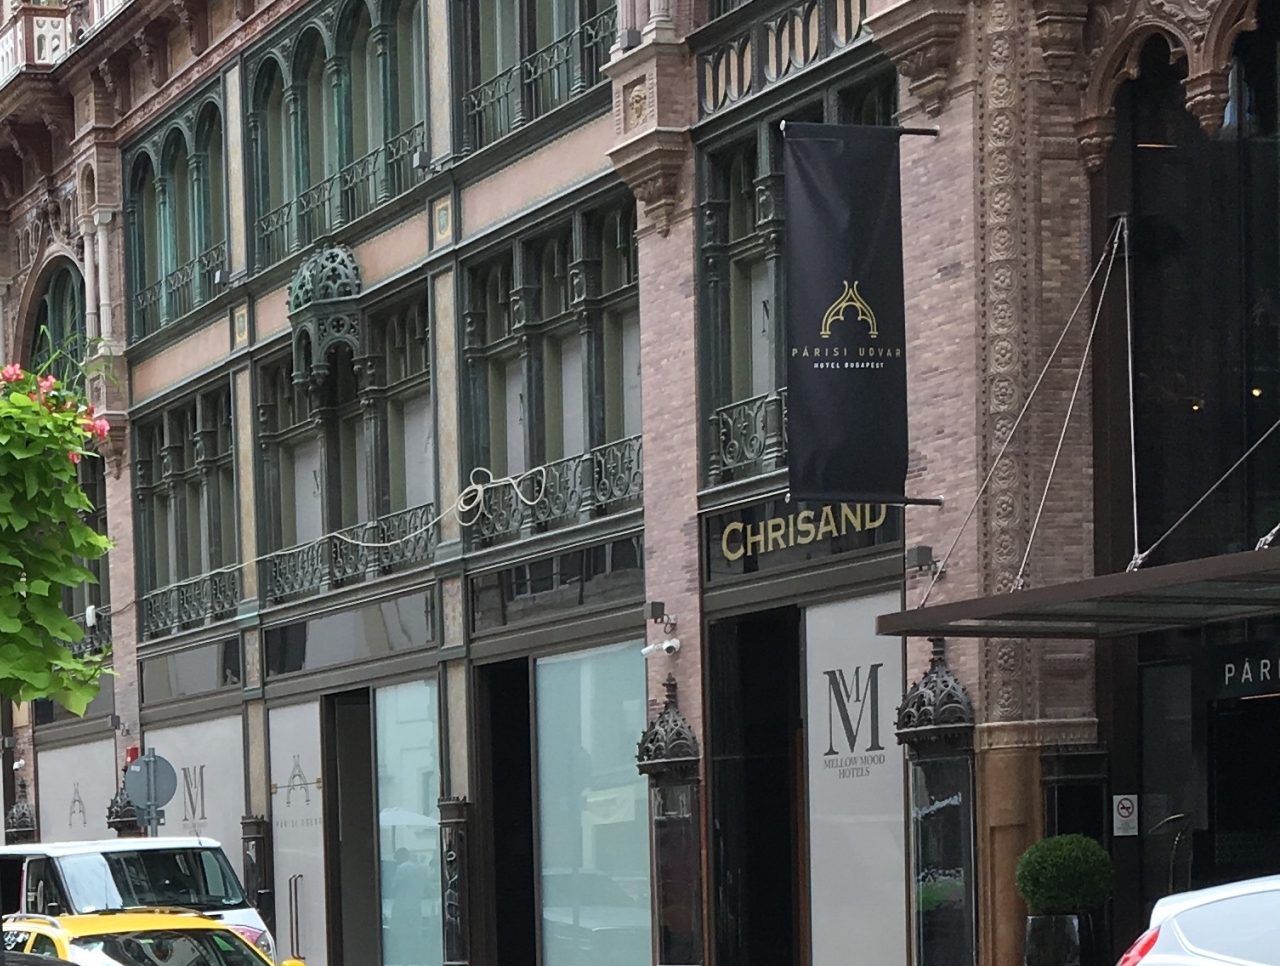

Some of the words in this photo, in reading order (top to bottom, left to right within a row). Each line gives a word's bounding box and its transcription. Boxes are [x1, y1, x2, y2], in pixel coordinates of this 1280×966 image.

[858, 347, 902, 358] UDVAR
[721, 503, 887, 561] CHRISAND
[823, 756, 858, 770] MELLOW
[859, 753, 886, 768] MOOD
[838, 766, 870, 779] HOTELS
